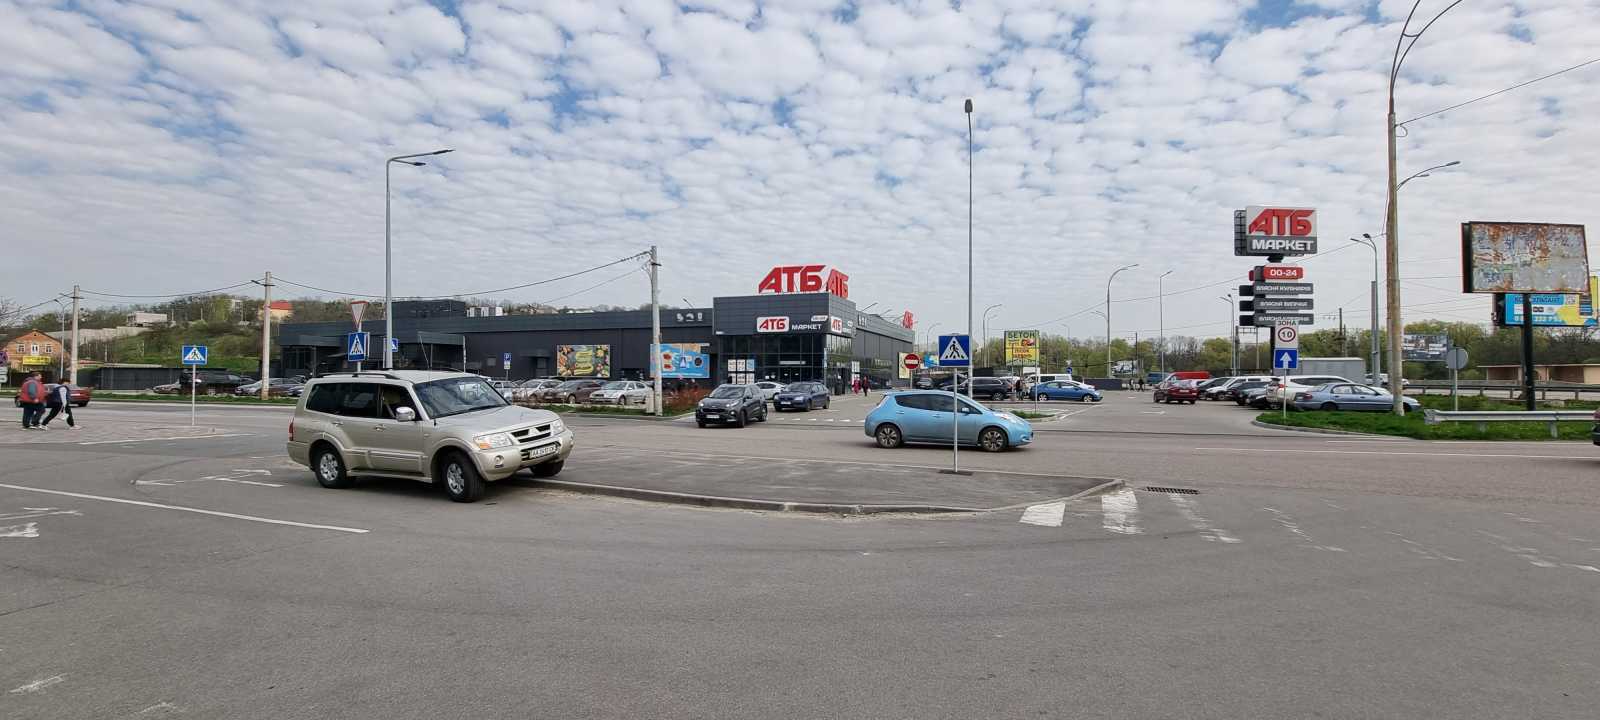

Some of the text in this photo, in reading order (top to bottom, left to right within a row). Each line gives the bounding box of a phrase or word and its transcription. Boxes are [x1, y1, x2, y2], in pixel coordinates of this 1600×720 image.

[1248, 208, 1316, 237] АТБ
[1252, 239, 1314, 250] МАРКЕТ
[758, 265, 826, 293] АТБ
[826, 268, 849, 298] АТБ
[759, 318, 786, 330] АТБ
[832, 319, 842, 331] АТБ
